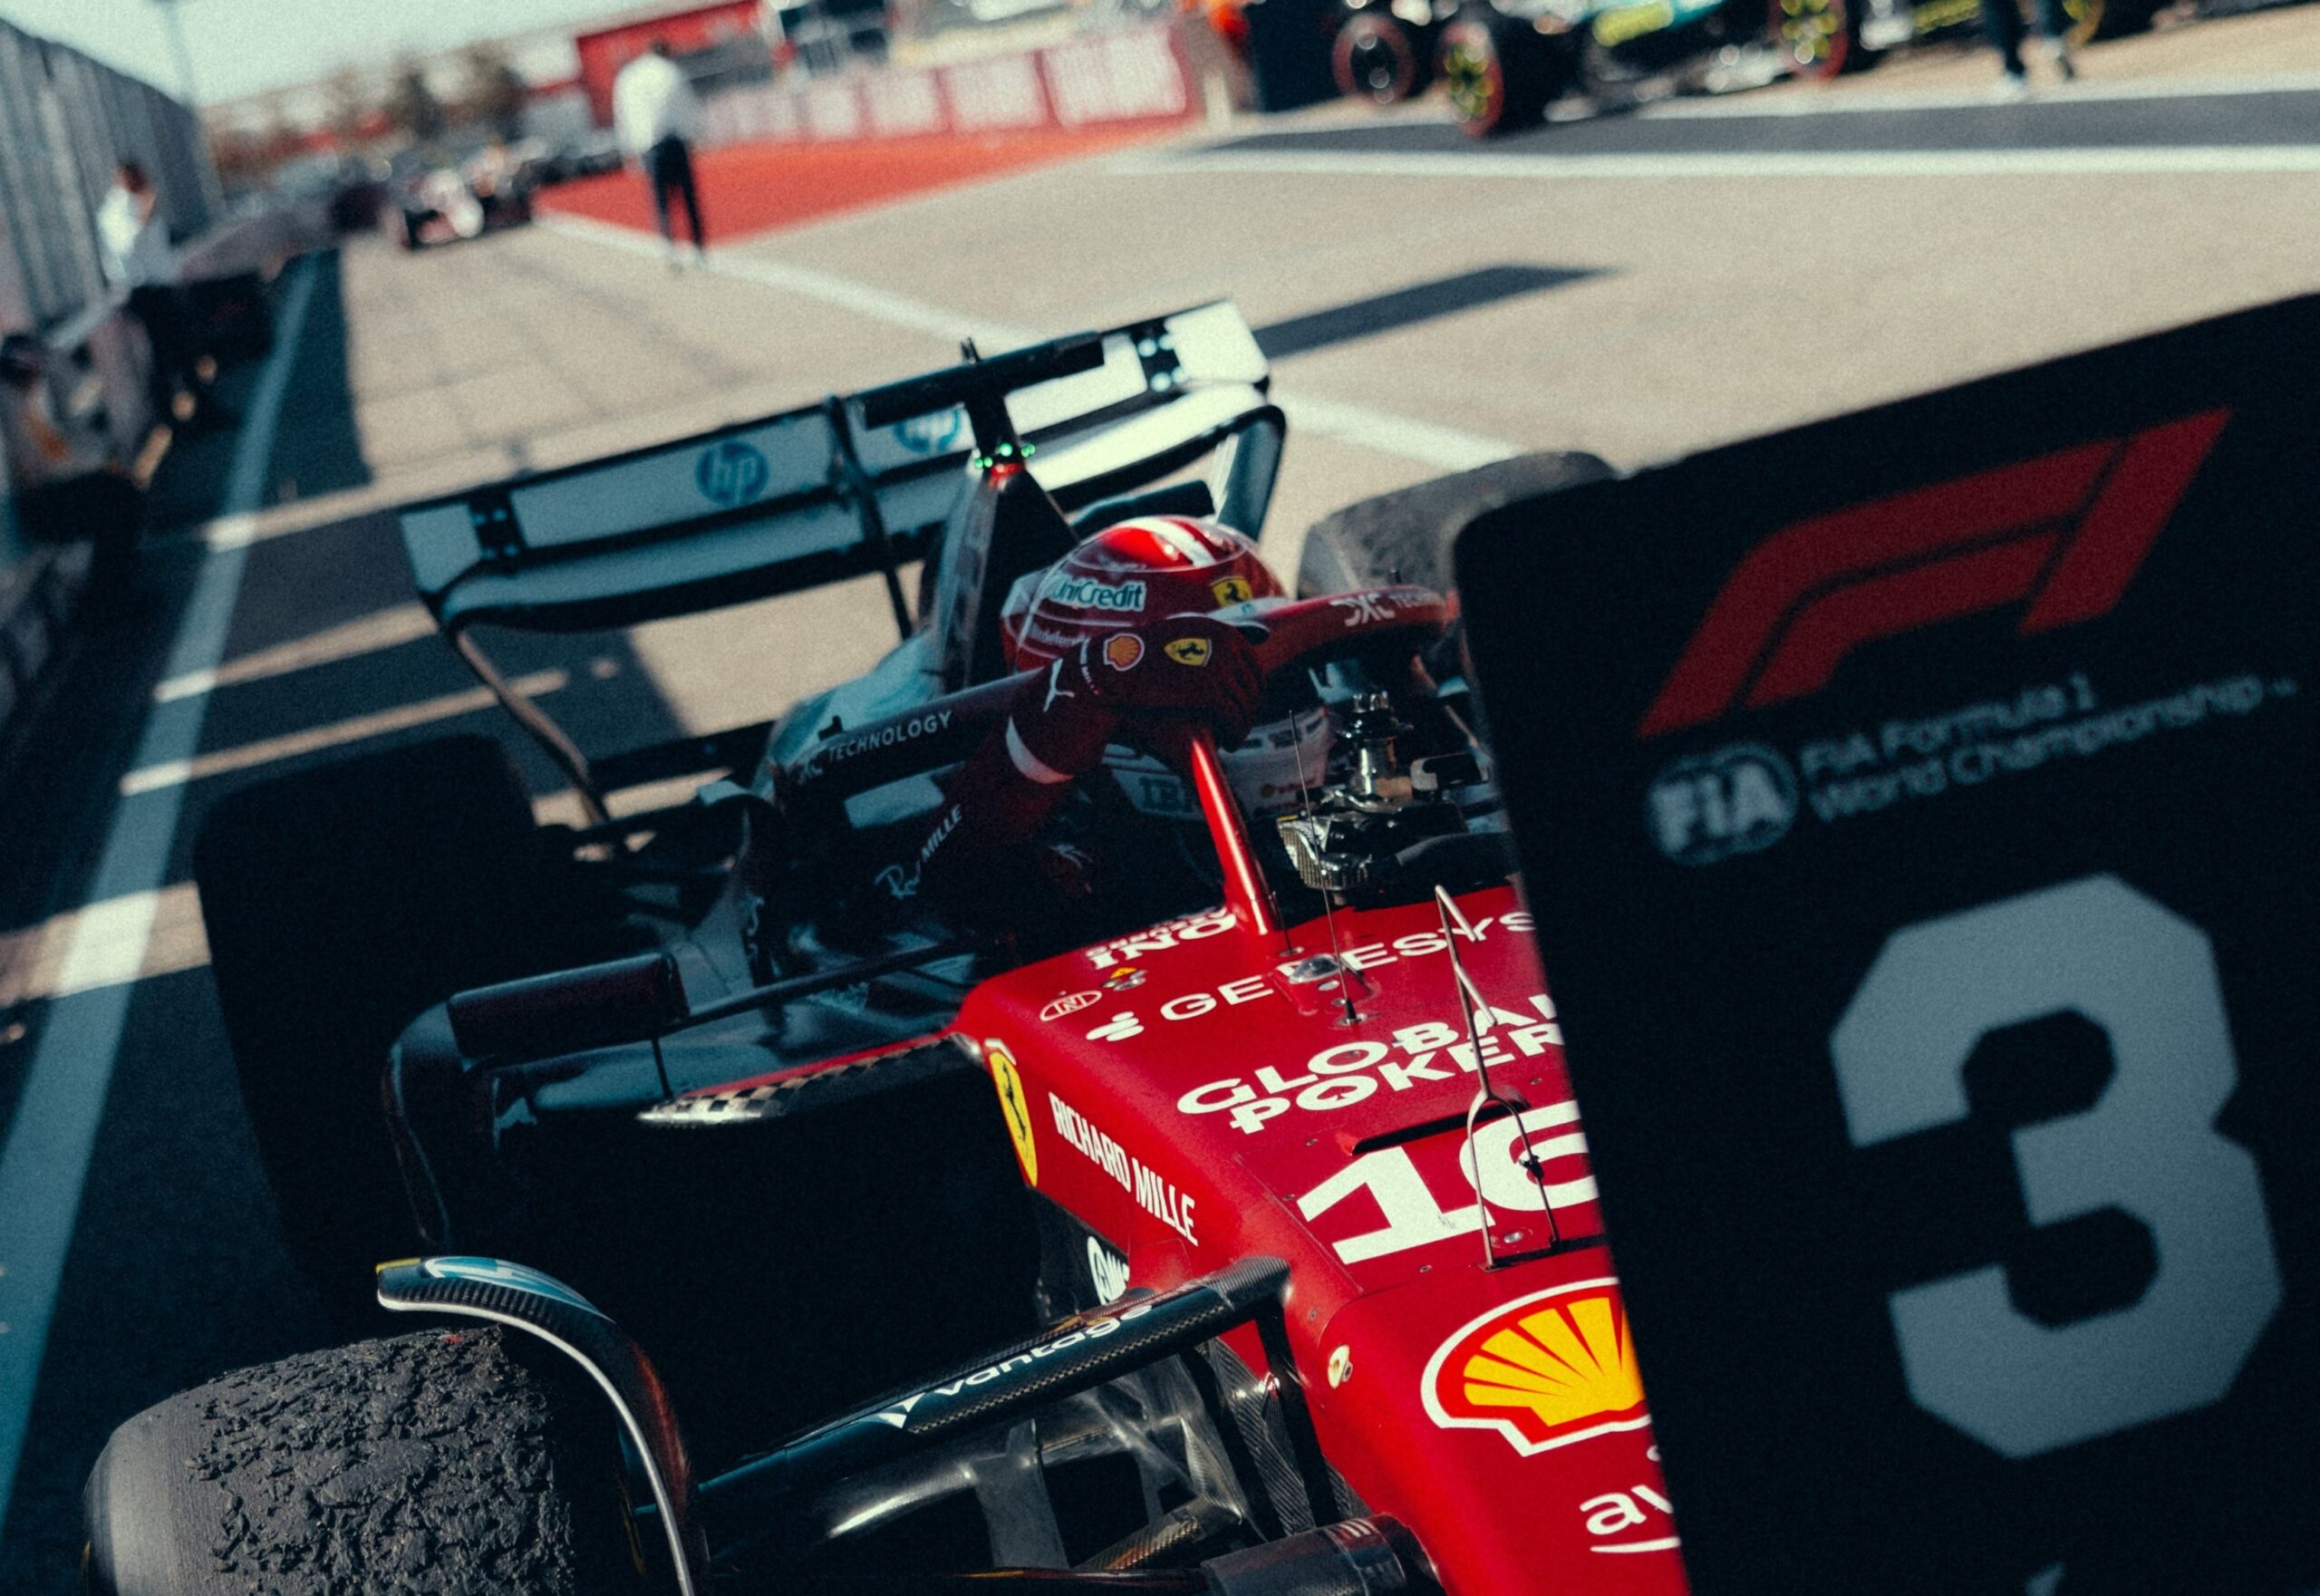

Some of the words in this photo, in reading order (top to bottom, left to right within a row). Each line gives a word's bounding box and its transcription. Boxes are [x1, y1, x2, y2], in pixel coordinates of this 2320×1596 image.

[1637, 406, 2233, 740] F1
[828, 711, 952, 761] TECHNOLOGY
[1882, 686, 2066, 758] Formula
[921, 804, 962, 863] MILLE
[1652, 763, 1794, 853] FIA
[1811, 759, 1948, 821] World
[1230, 1023, 1566, 1135] POKER
[1049, 1091, 1131, 1193] RICHARD
[1132, 1157, 1199, 1247] MILLE
[1296, 1099, 1600, 1265] 16
[1829, 872, 2284, 1460] 3
[934, 1305, 1152, 1397] vantage
